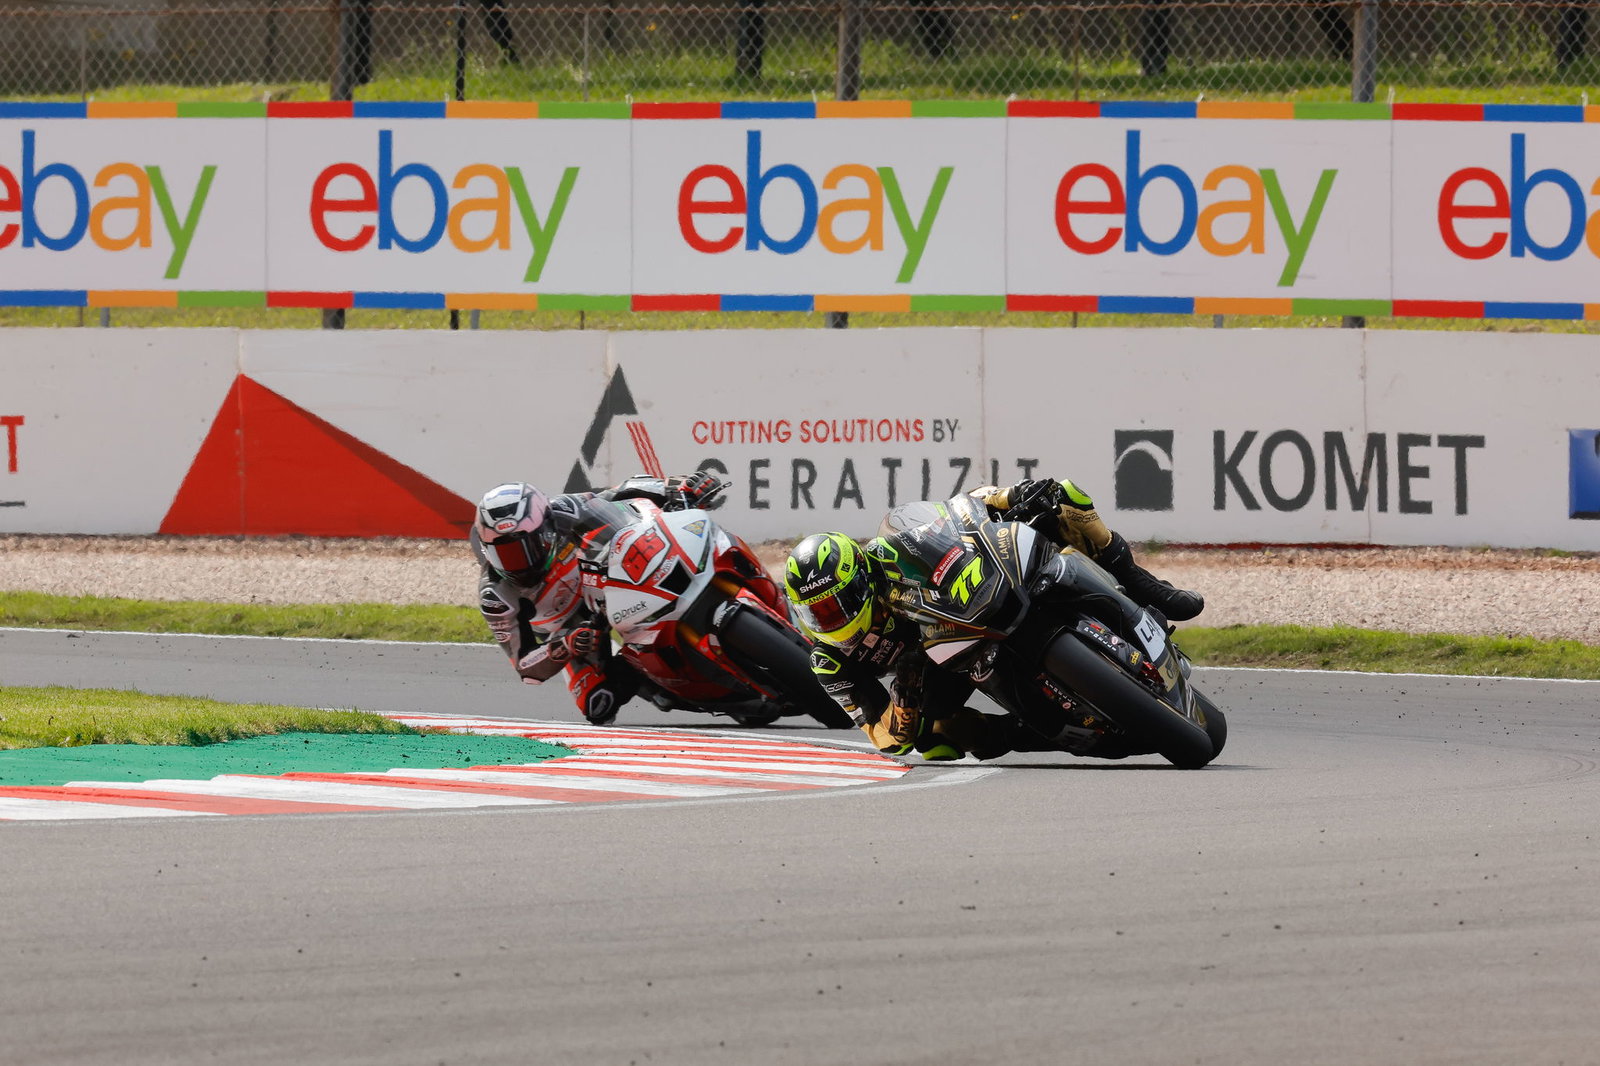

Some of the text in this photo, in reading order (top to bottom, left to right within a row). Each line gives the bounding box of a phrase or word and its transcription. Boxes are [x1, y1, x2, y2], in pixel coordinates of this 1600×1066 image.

[310, 130, 580, 282] ebay
[678, 130, 954, 283] ebay
[1055, 130, 1338, 287] ebay
[1438, 133, 1600, 260] eb
[692, 418, 959, 445] CUTTING SOLUTIONS BY
[1213, 429, 1485, 516] KOMET
[799, 574, 833, 594] SHARK
[950, 555, 983, 606] 77
